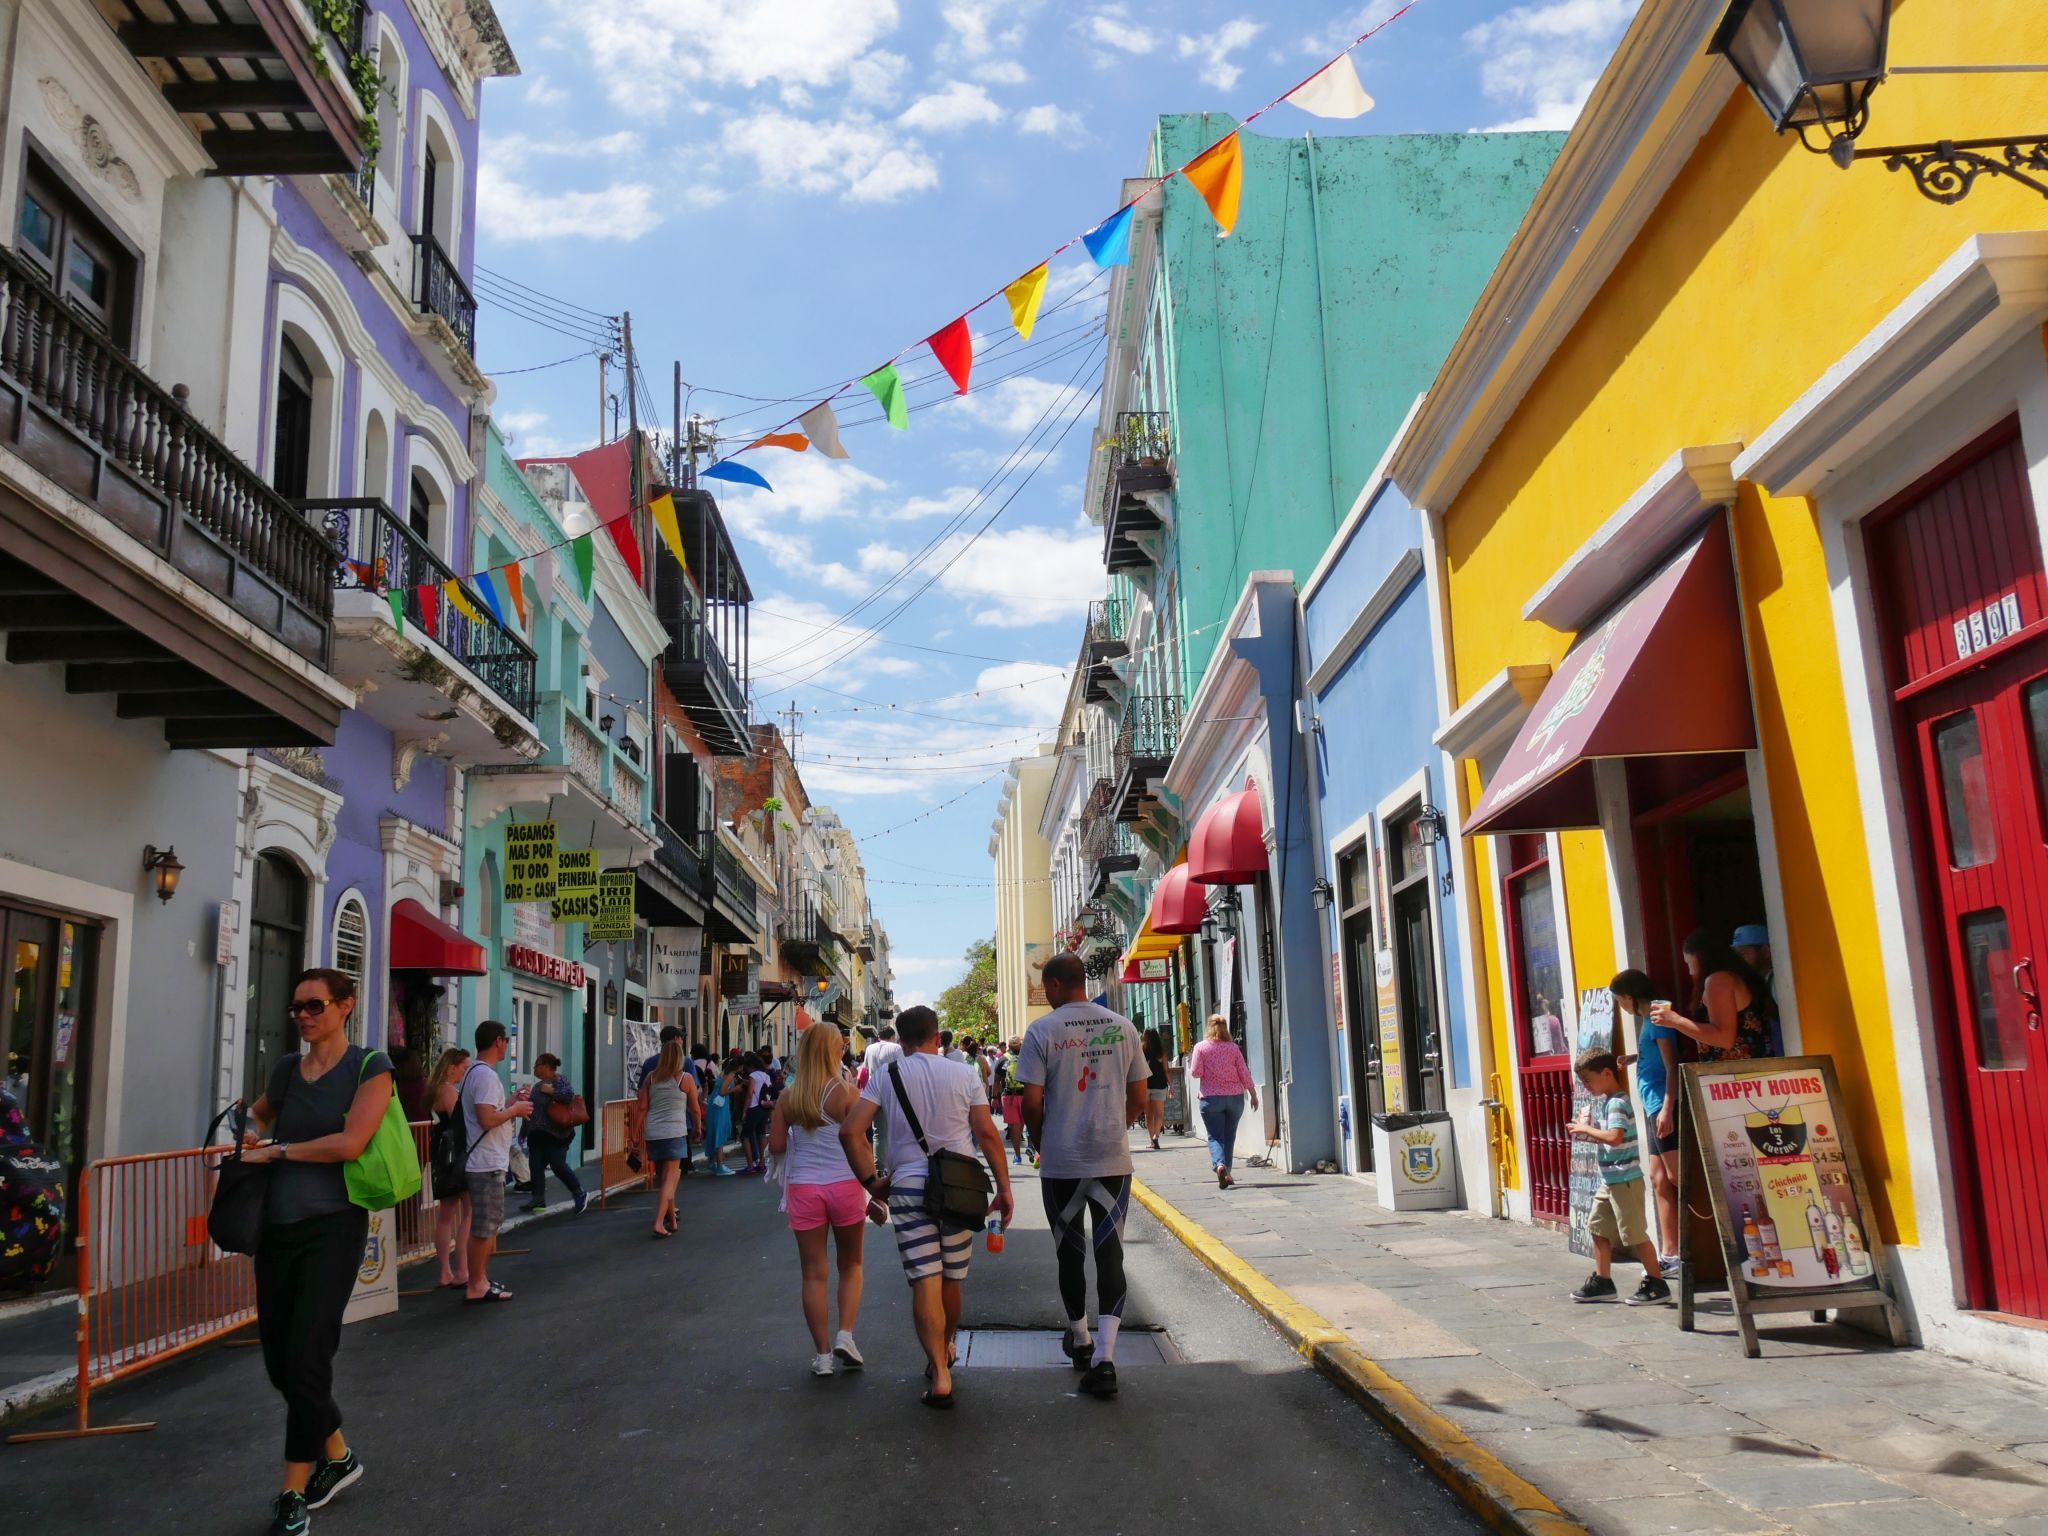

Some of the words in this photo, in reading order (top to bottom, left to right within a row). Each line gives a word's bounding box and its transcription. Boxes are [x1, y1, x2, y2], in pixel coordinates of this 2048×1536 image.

[507, 824, 555, 841] PAGAMOS
[509, 844, 529, 860] MAS
[533, 843, 553, 859] POR
[559, 852, 591, 868] SOMOS
[512, 864, 524, 880] TU
[528, 863, 549, 879] ORO
[558, 871, 597, 887] EFINERIA
[505, 883, 523, 899] ORO
[600, 897, 631, 906] LATA
[511, 944, 540, 974] CASA
[541, 953, 553, 977] DE
[1064, 1018, 1113, 1027] POWERED
[1081, 1050, 1113, 1058] FUELED
[1709, 1080, 1762, 1101] HAPPY
[1767, 1077, 1822, 1096] HOURS
[1774, 1134, 1783, 1145] 3
